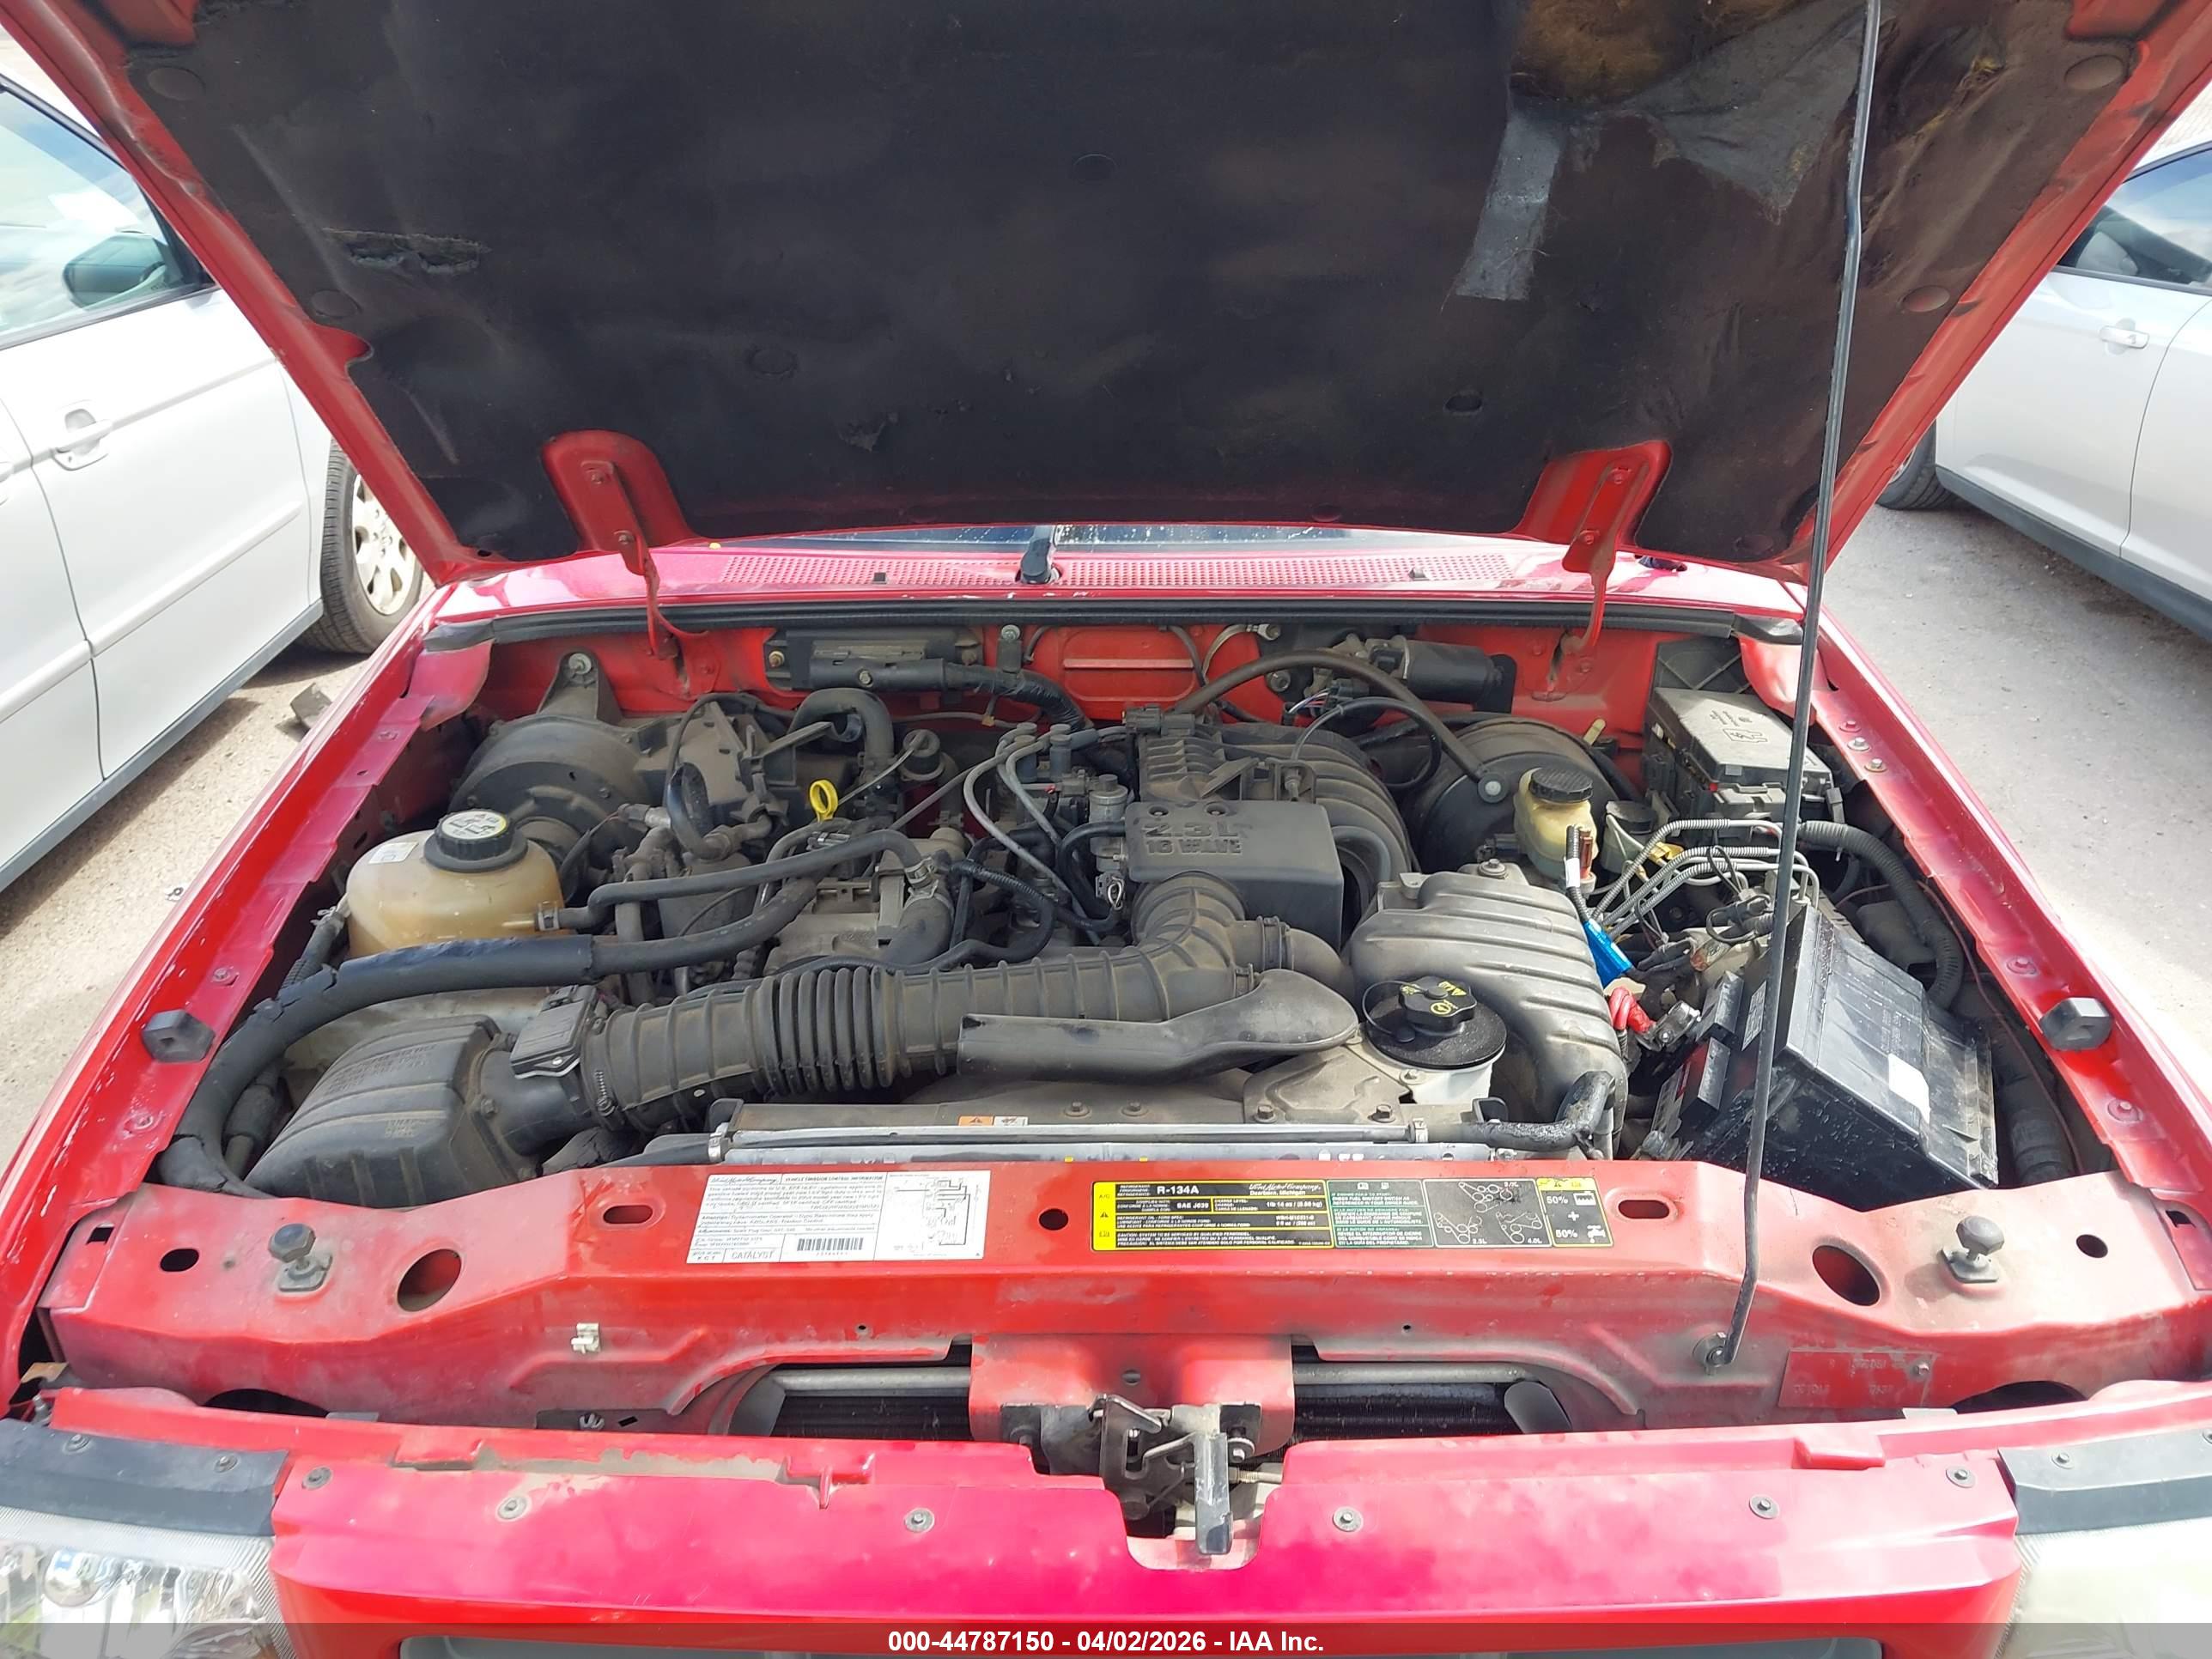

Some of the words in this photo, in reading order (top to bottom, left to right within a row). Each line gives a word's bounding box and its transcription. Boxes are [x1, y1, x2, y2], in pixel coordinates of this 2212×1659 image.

[1146, 839, 1174, 855] 16
[1157, 1185, 1200, 1195] R-134A
[1546, 1194, 1569, 1205] 50%
[1555, 1229, 1579, 1239] 50%
[731, 1250, 775, 1260] CATALYST
